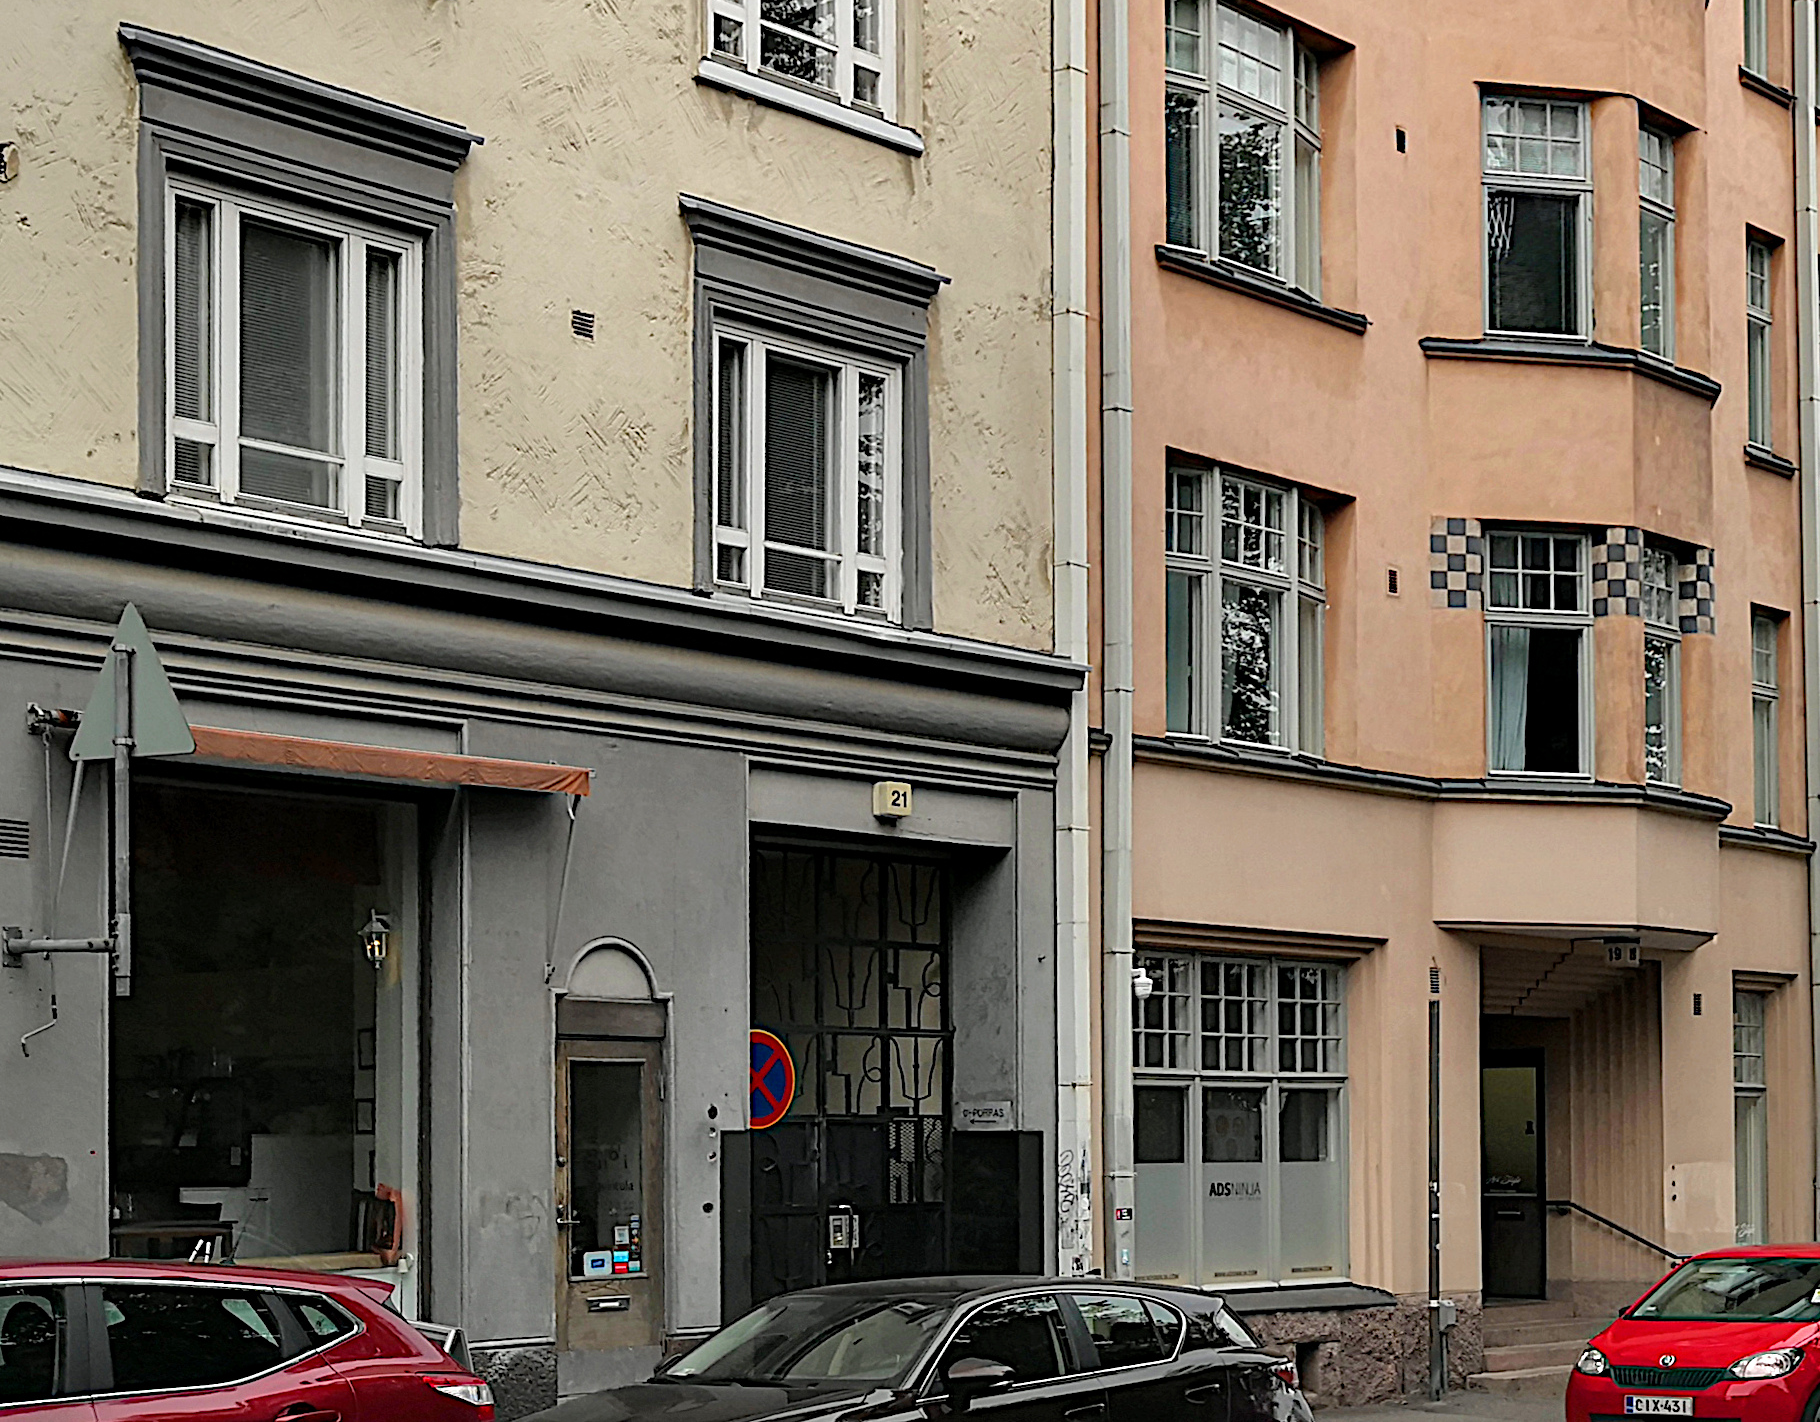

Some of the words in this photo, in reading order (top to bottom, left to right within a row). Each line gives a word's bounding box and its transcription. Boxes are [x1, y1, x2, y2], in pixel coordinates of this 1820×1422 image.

[891, 790, 907, 808] 21
[1608, 947, 1622, 962] 19
[1635, 1398, 1687, 1414] CIX-431
